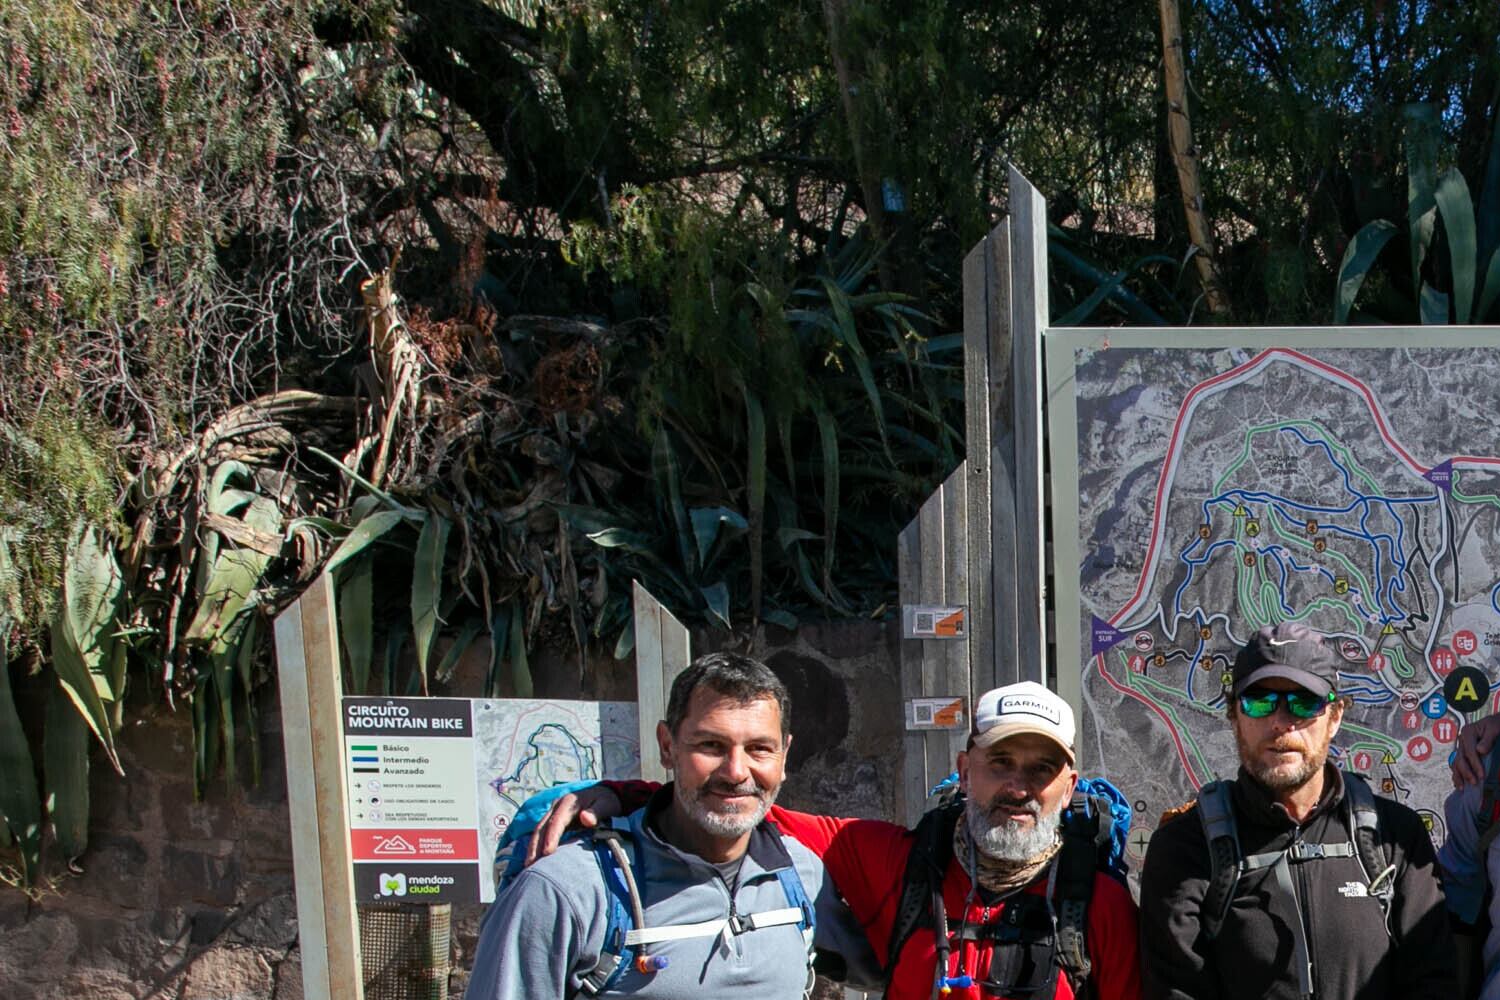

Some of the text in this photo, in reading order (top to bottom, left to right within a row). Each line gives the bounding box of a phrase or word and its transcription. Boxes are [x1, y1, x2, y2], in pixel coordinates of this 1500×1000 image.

[1454, 676, 1479, 701] A
[348, 705, 409, 717] CIRCUITO
[1429, 698, 1441, 714] E
[349, 716, 463, 730] MOUNTAIN BIKE
[383, 744, 409, 752] Básico
[383, 756, 430, 765] Intermedio
[384, 767, 424, 775] Avanzado
[408, 875, 455, 885] mendoza
[409, 884, 440, 894] ciudad
